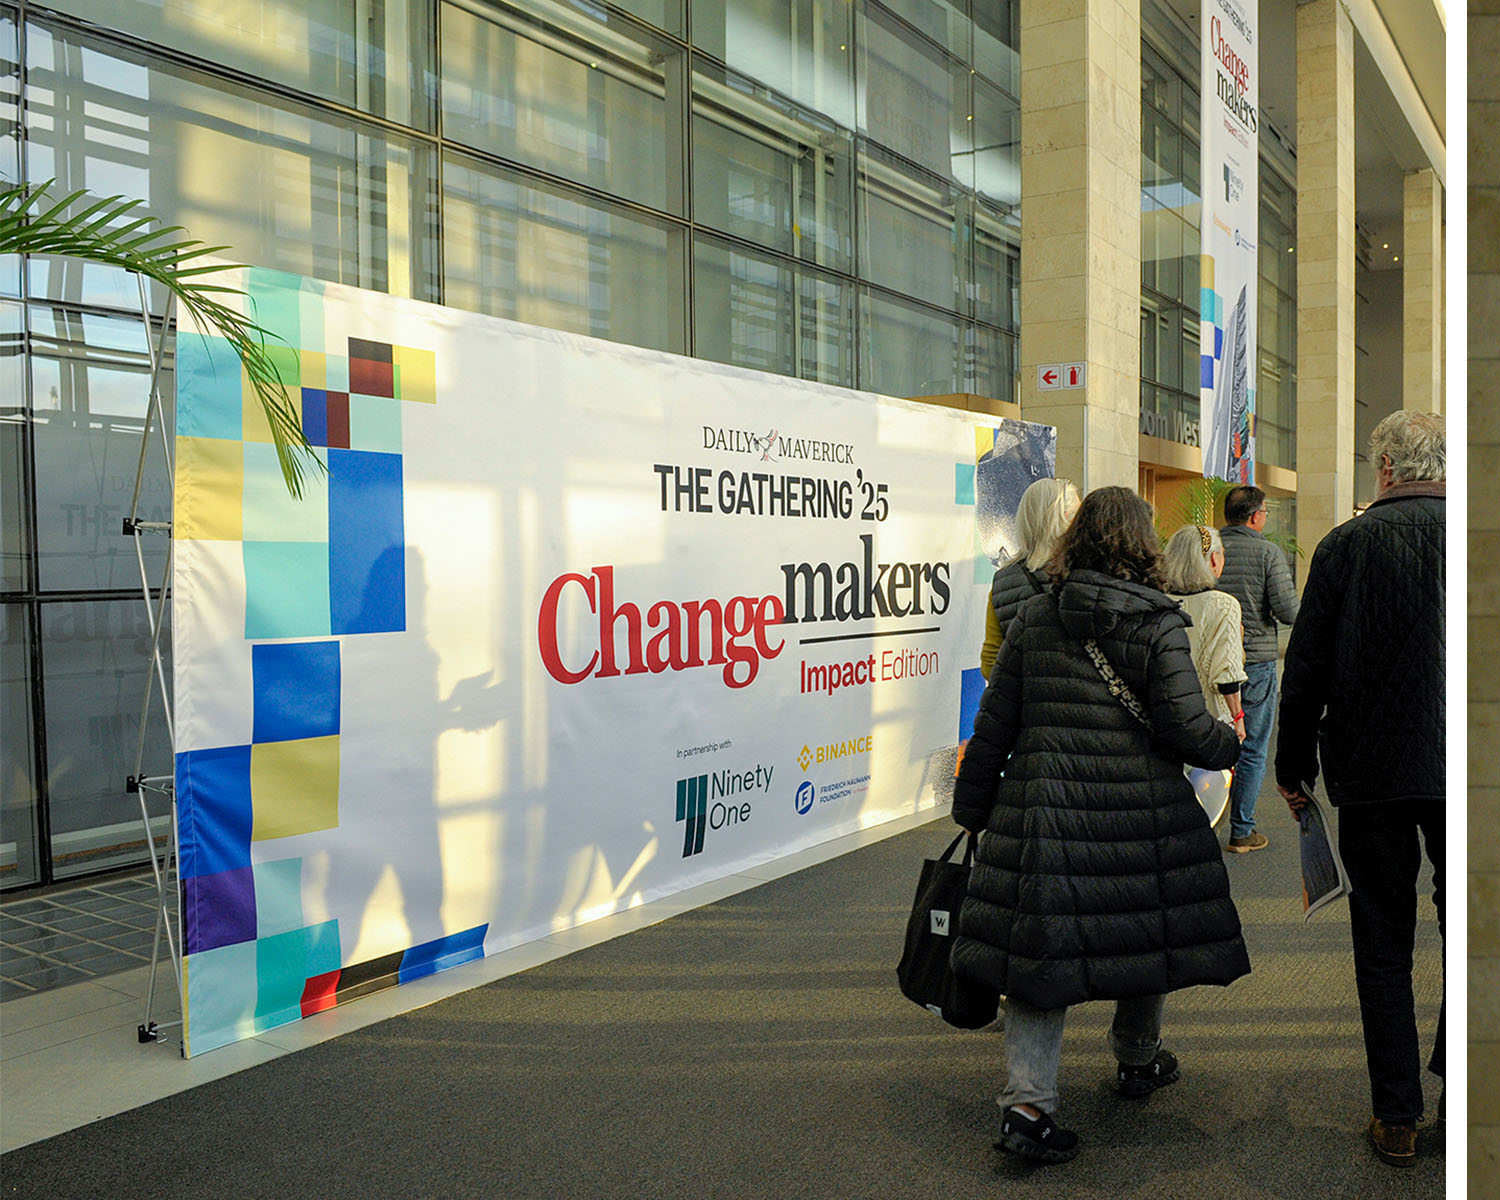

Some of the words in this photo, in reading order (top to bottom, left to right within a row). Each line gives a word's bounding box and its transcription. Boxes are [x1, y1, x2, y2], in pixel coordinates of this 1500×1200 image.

[1210, 15, 1249, 96] Change
[1216, 69, 1257, 134] makers
[702, 426, 755, 454] DAILY
[778, 436, 855, 465] MAVERICK
[653, 464, 713, 514] THE
[718, 470, 853, 520] GATHERING
[856, 468, 889, 522] '25
[780, 534, 951, 624] makers
[538, 565, 786, 689] Change
[800, 653, 876, 695] Impact
[880, 647, 939, 683] Edition
[683, 742, 718, 760] partnership
[718, 739, 732, 751] with
[816, 735, 873, 764] BINANCE
[711, 764, 774, 800] Ninety
[709, 802, 752, 831] One
[935, 917, 946, 928] W
